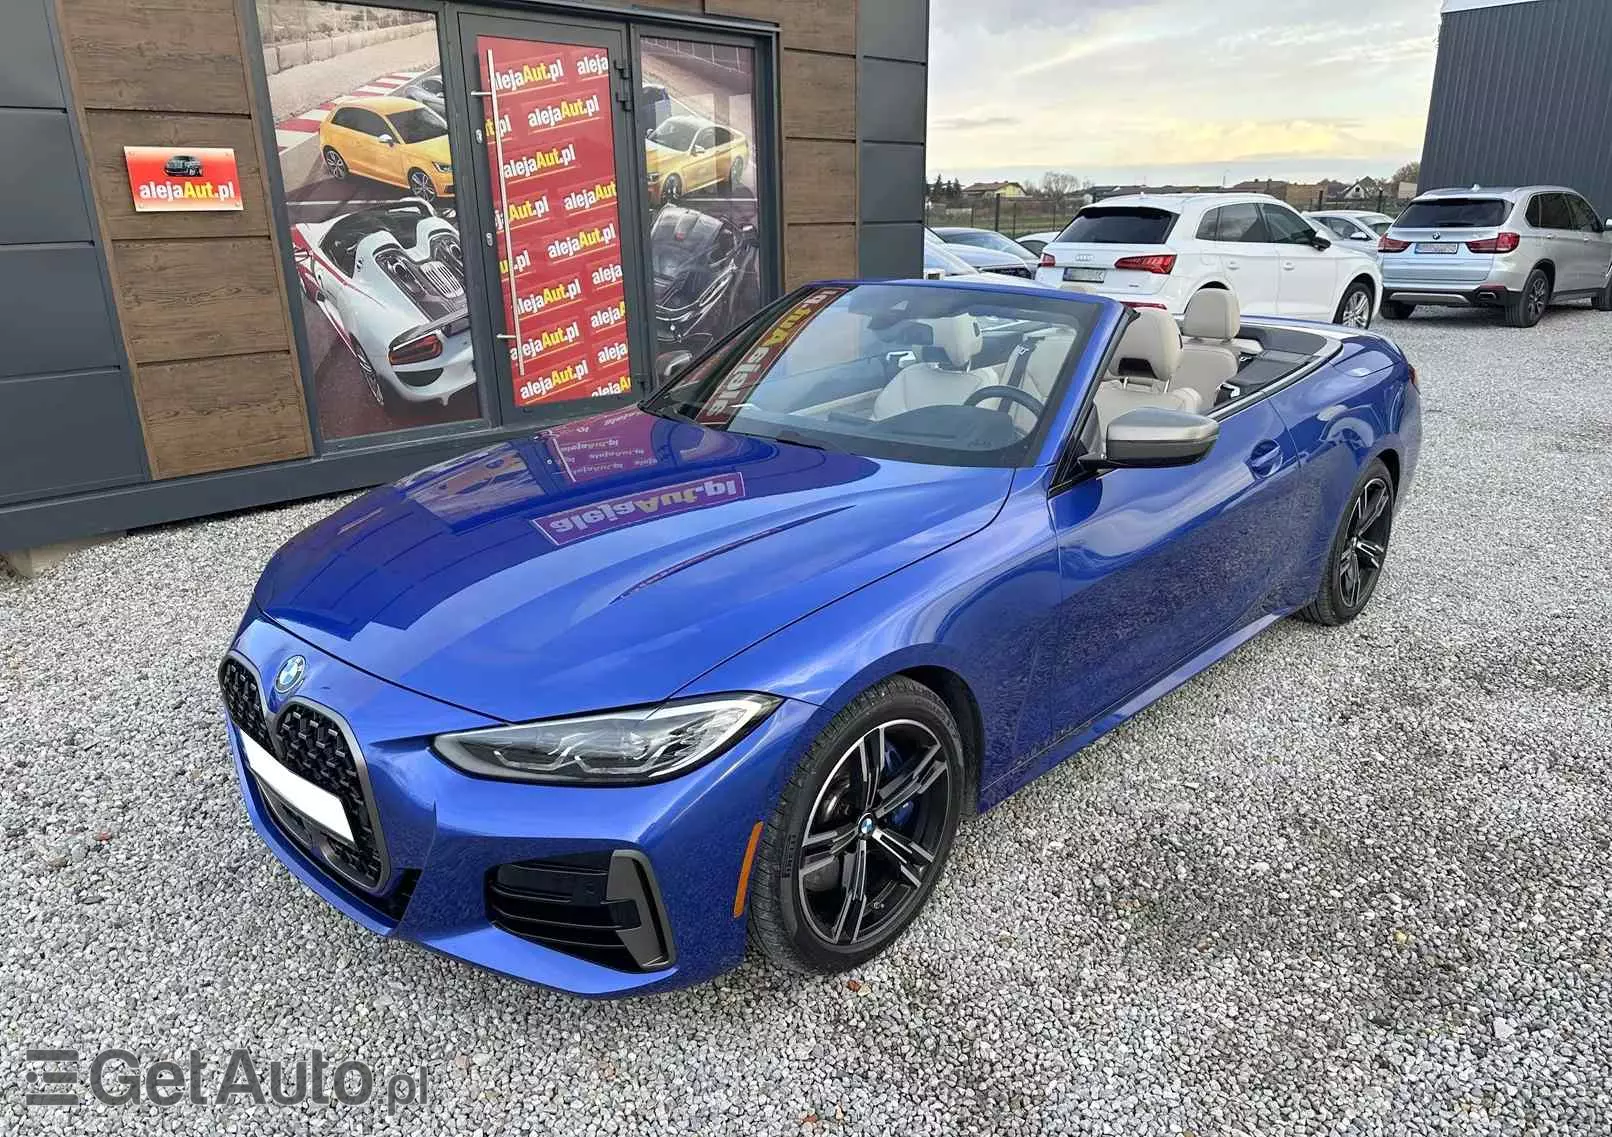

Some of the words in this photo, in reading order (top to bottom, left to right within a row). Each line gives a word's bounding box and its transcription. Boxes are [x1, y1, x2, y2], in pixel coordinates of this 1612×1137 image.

[528, 95, 599, 128] alejaAut.pl
[502, 144, 576, 178] alejaAut.pl
[138, 181, 235, 201] alejaAut.pl
[547, 223, 616, 259] alejaAut.pl
[591, 264, 623, 285] aleja
[510, 321, 579, 361] aejaAut.pl
[597, 342, 628, 363] aleja
[520, 360, 589, 399] alejaAut.pl
